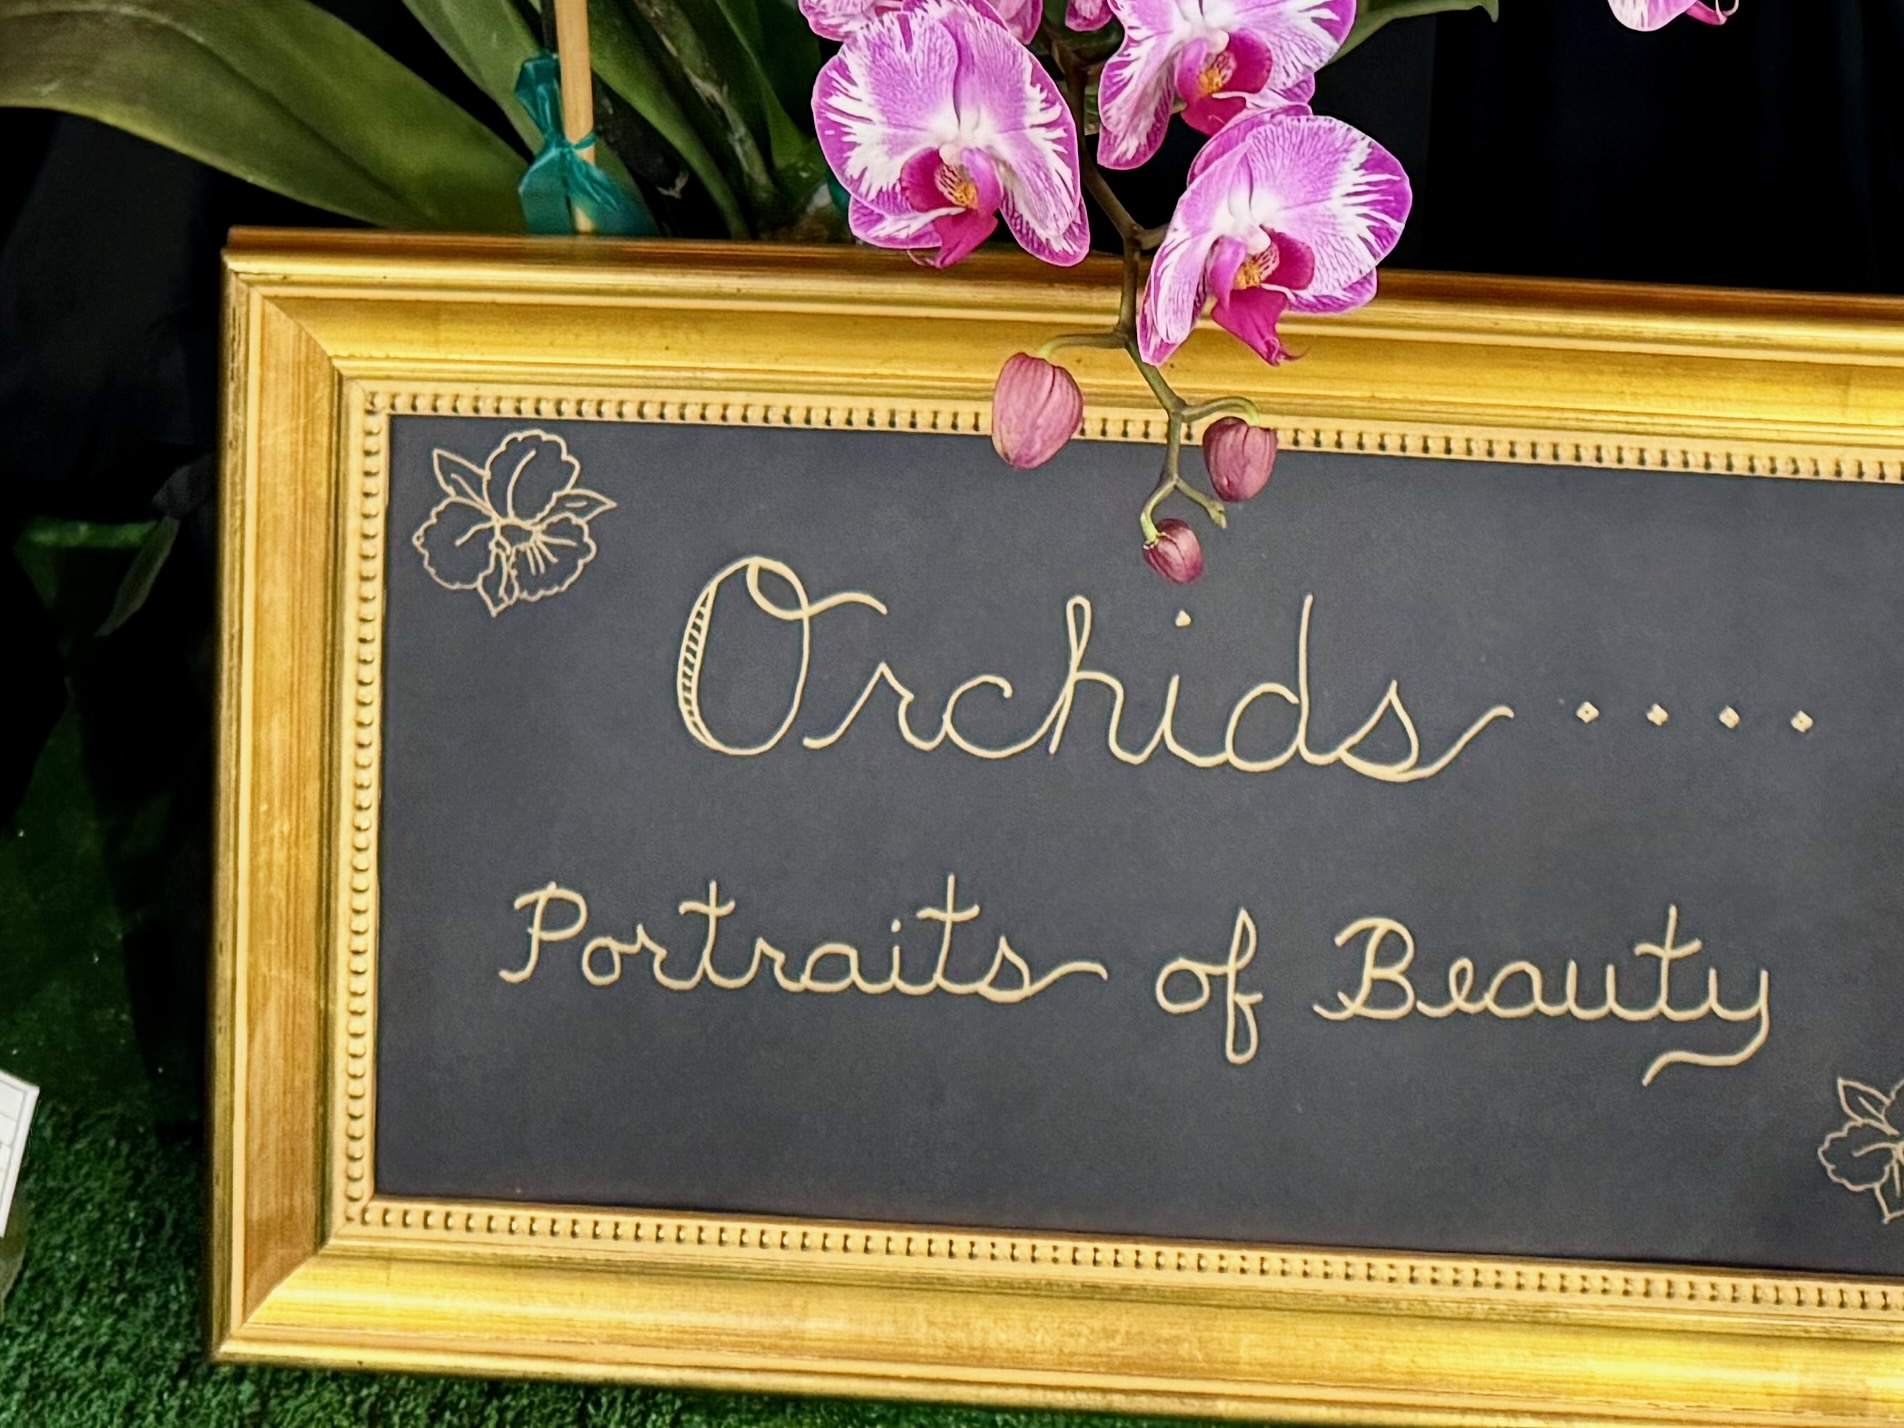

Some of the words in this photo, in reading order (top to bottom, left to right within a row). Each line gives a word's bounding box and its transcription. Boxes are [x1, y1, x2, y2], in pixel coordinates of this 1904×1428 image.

[678, 555, 1515, 782] Orchids
[500, 874, 1108, 1003] Portraits
[1156, 910, 1264, 1065] of
[1315, 906, 1771, 1087] Beauty
